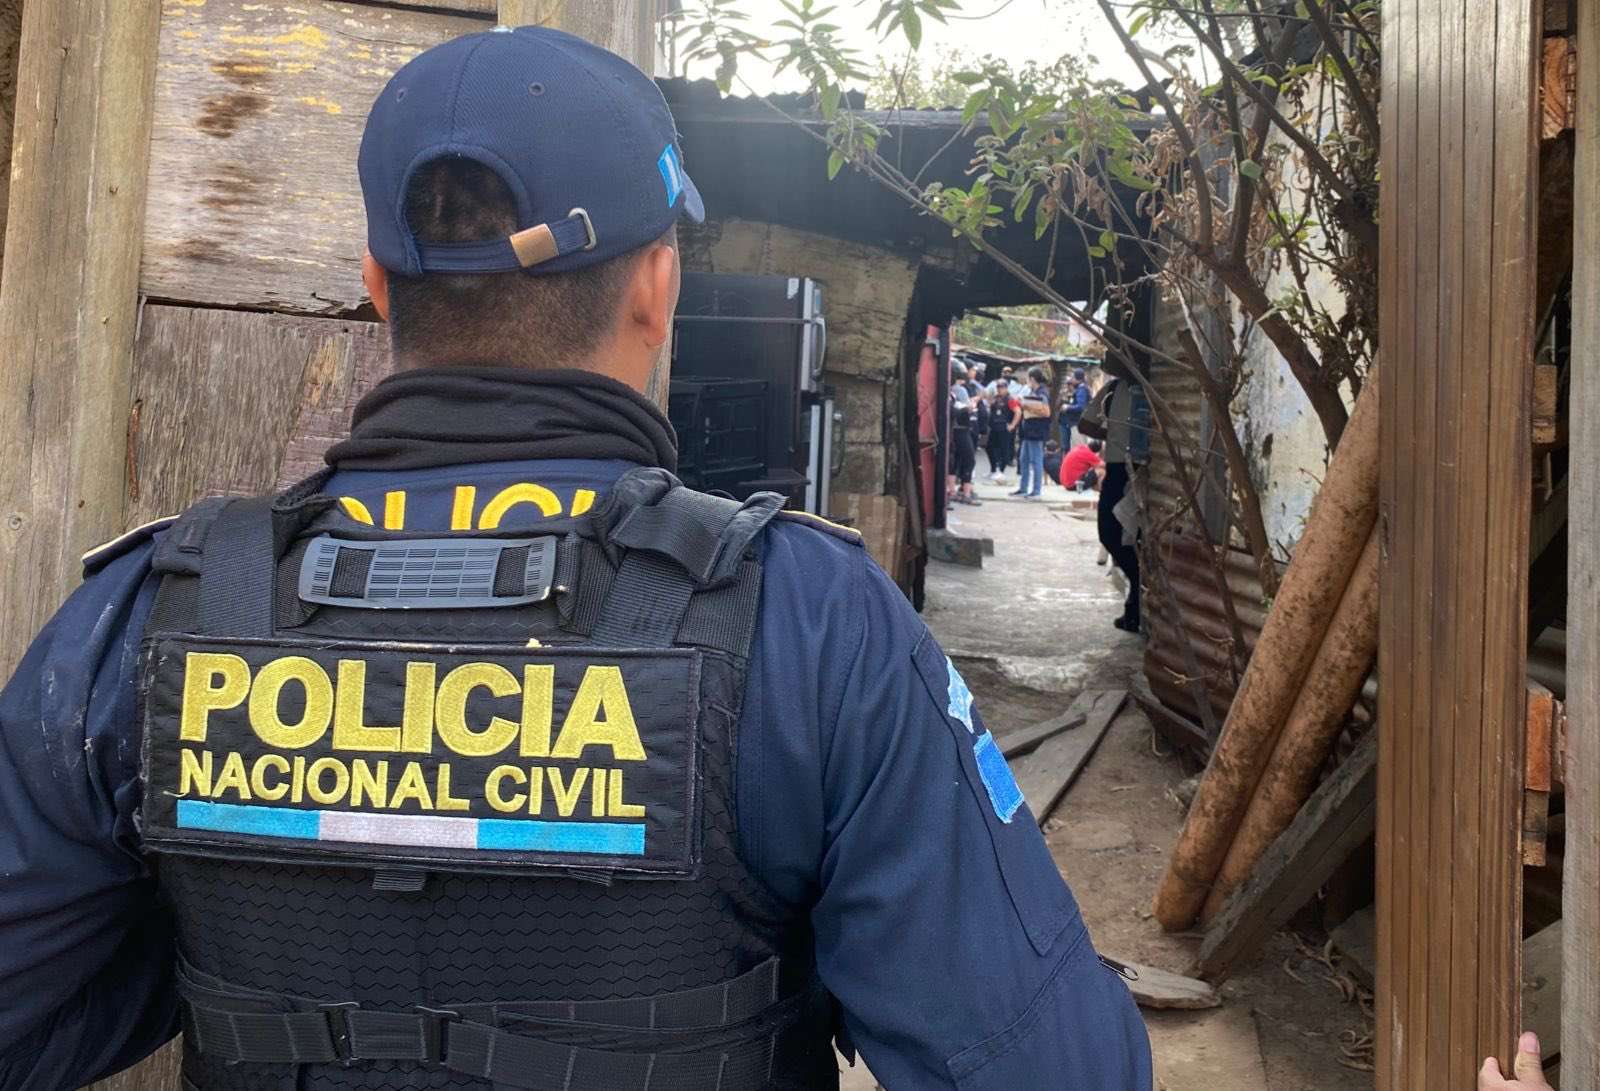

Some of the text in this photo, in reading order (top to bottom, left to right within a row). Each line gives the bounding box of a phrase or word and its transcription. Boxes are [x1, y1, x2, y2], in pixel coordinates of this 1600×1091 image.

[179, 652, 647, 761] POLICIA
[179, 749, 646, 818] NACIONAL CIVIL
